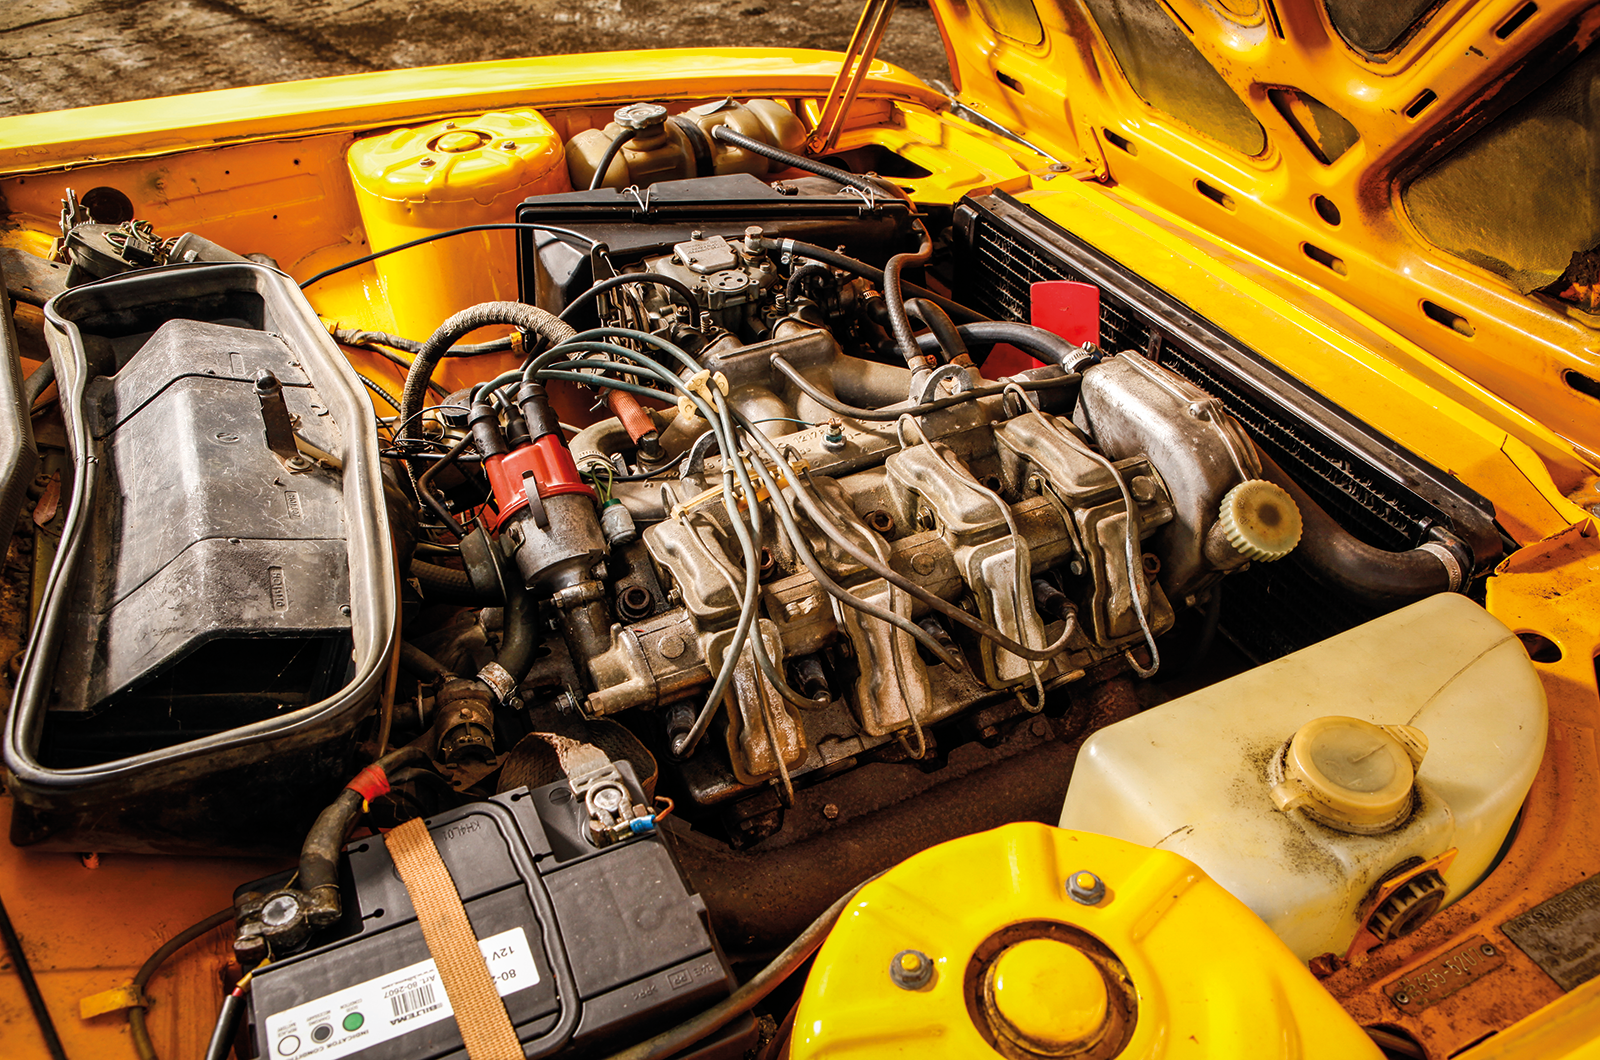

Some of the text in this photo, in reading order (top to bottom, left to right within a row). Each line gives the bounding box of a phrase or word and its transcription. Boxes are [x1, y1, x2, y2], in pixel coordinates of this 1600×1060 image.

[492, 945, 515, 961] 12V
[1414, 946, 1485, 992] 335-5207
[383, 974, 436, 999] Art. 80-2607
[389, 1003, 440, 1026] BILTEMA
[326, 1029, 369, 1049] INDICATOR
